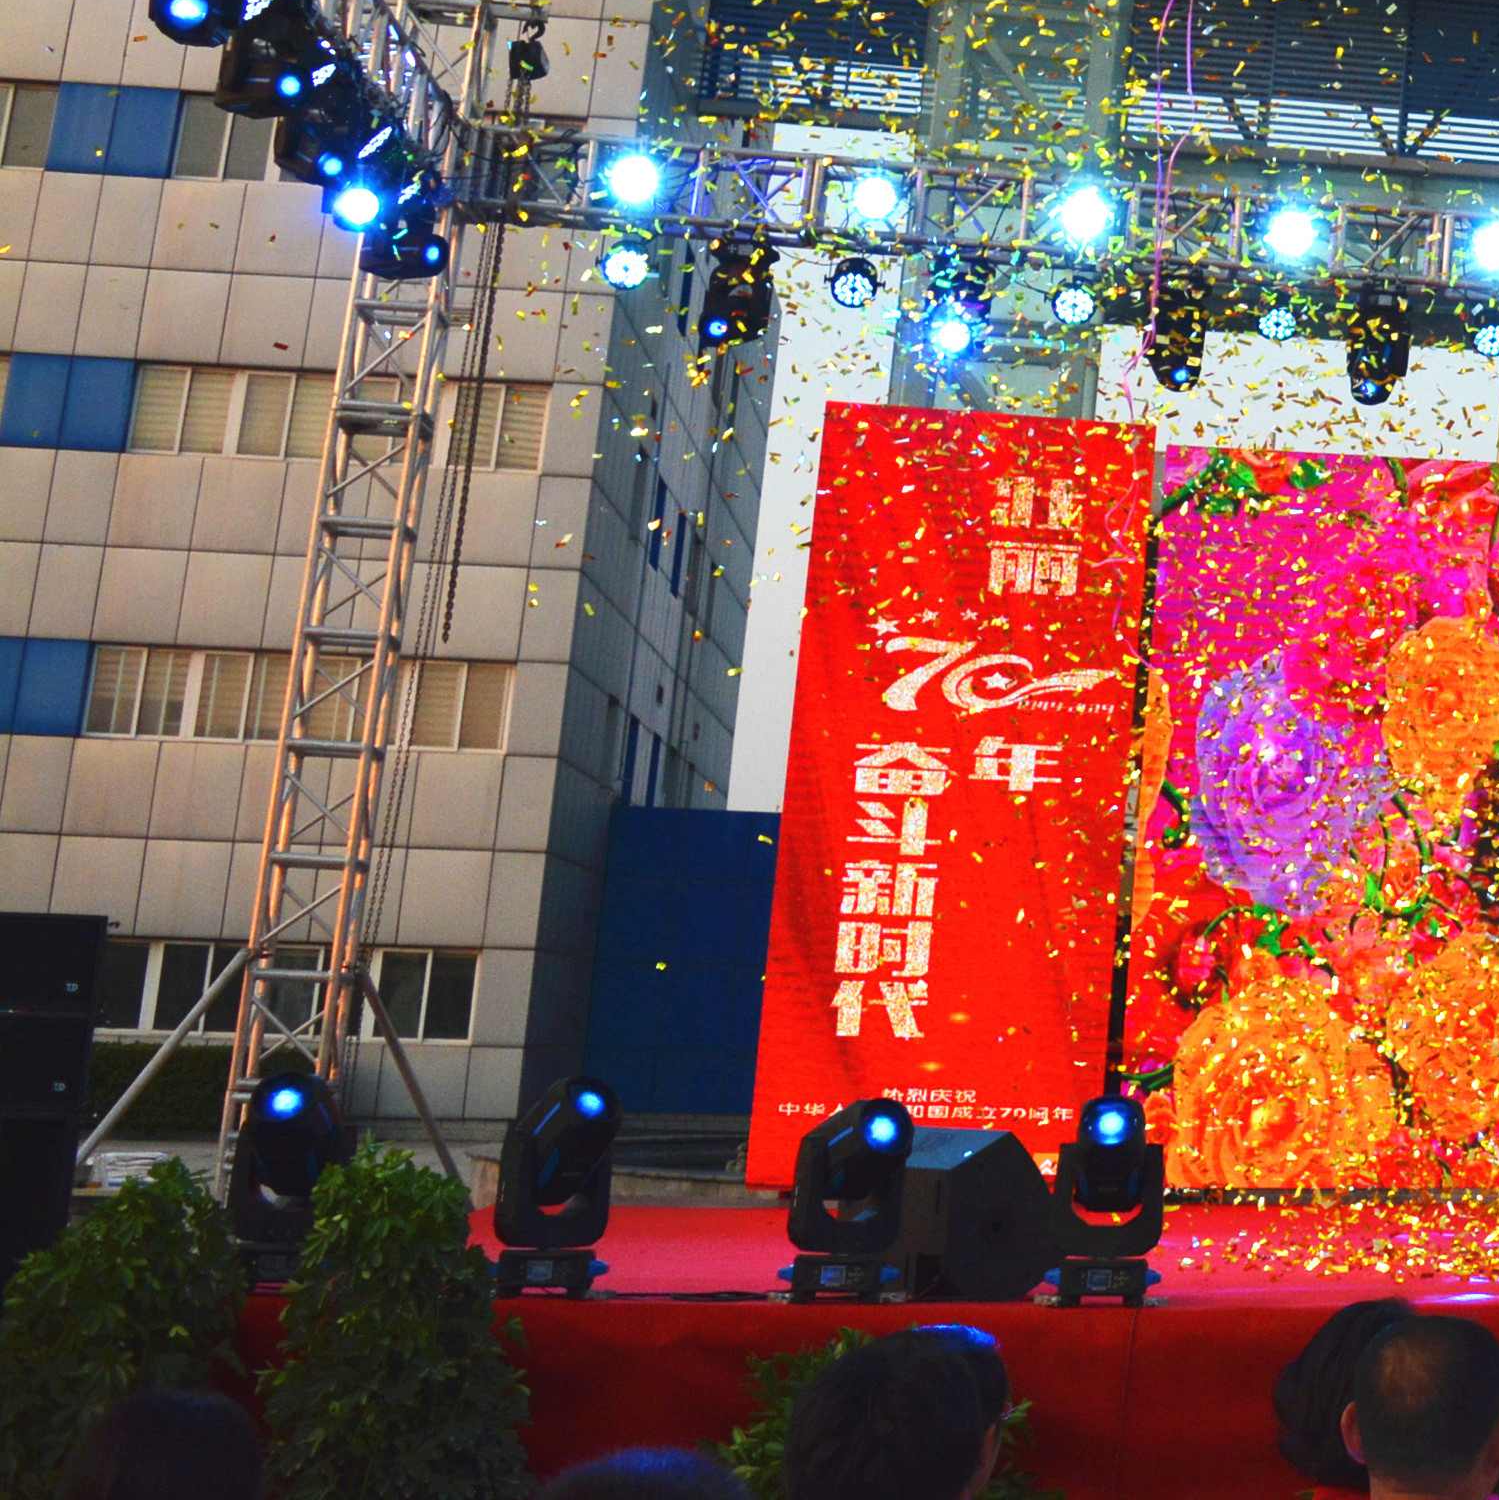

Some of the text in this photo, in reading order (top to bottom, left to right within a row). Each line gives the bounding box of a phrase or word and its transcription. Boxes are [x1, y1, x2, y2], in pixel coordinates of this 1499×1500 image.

[968, 736, 1064, 792] 年
[831, 742, 951, 1038] 奋斗新时代
